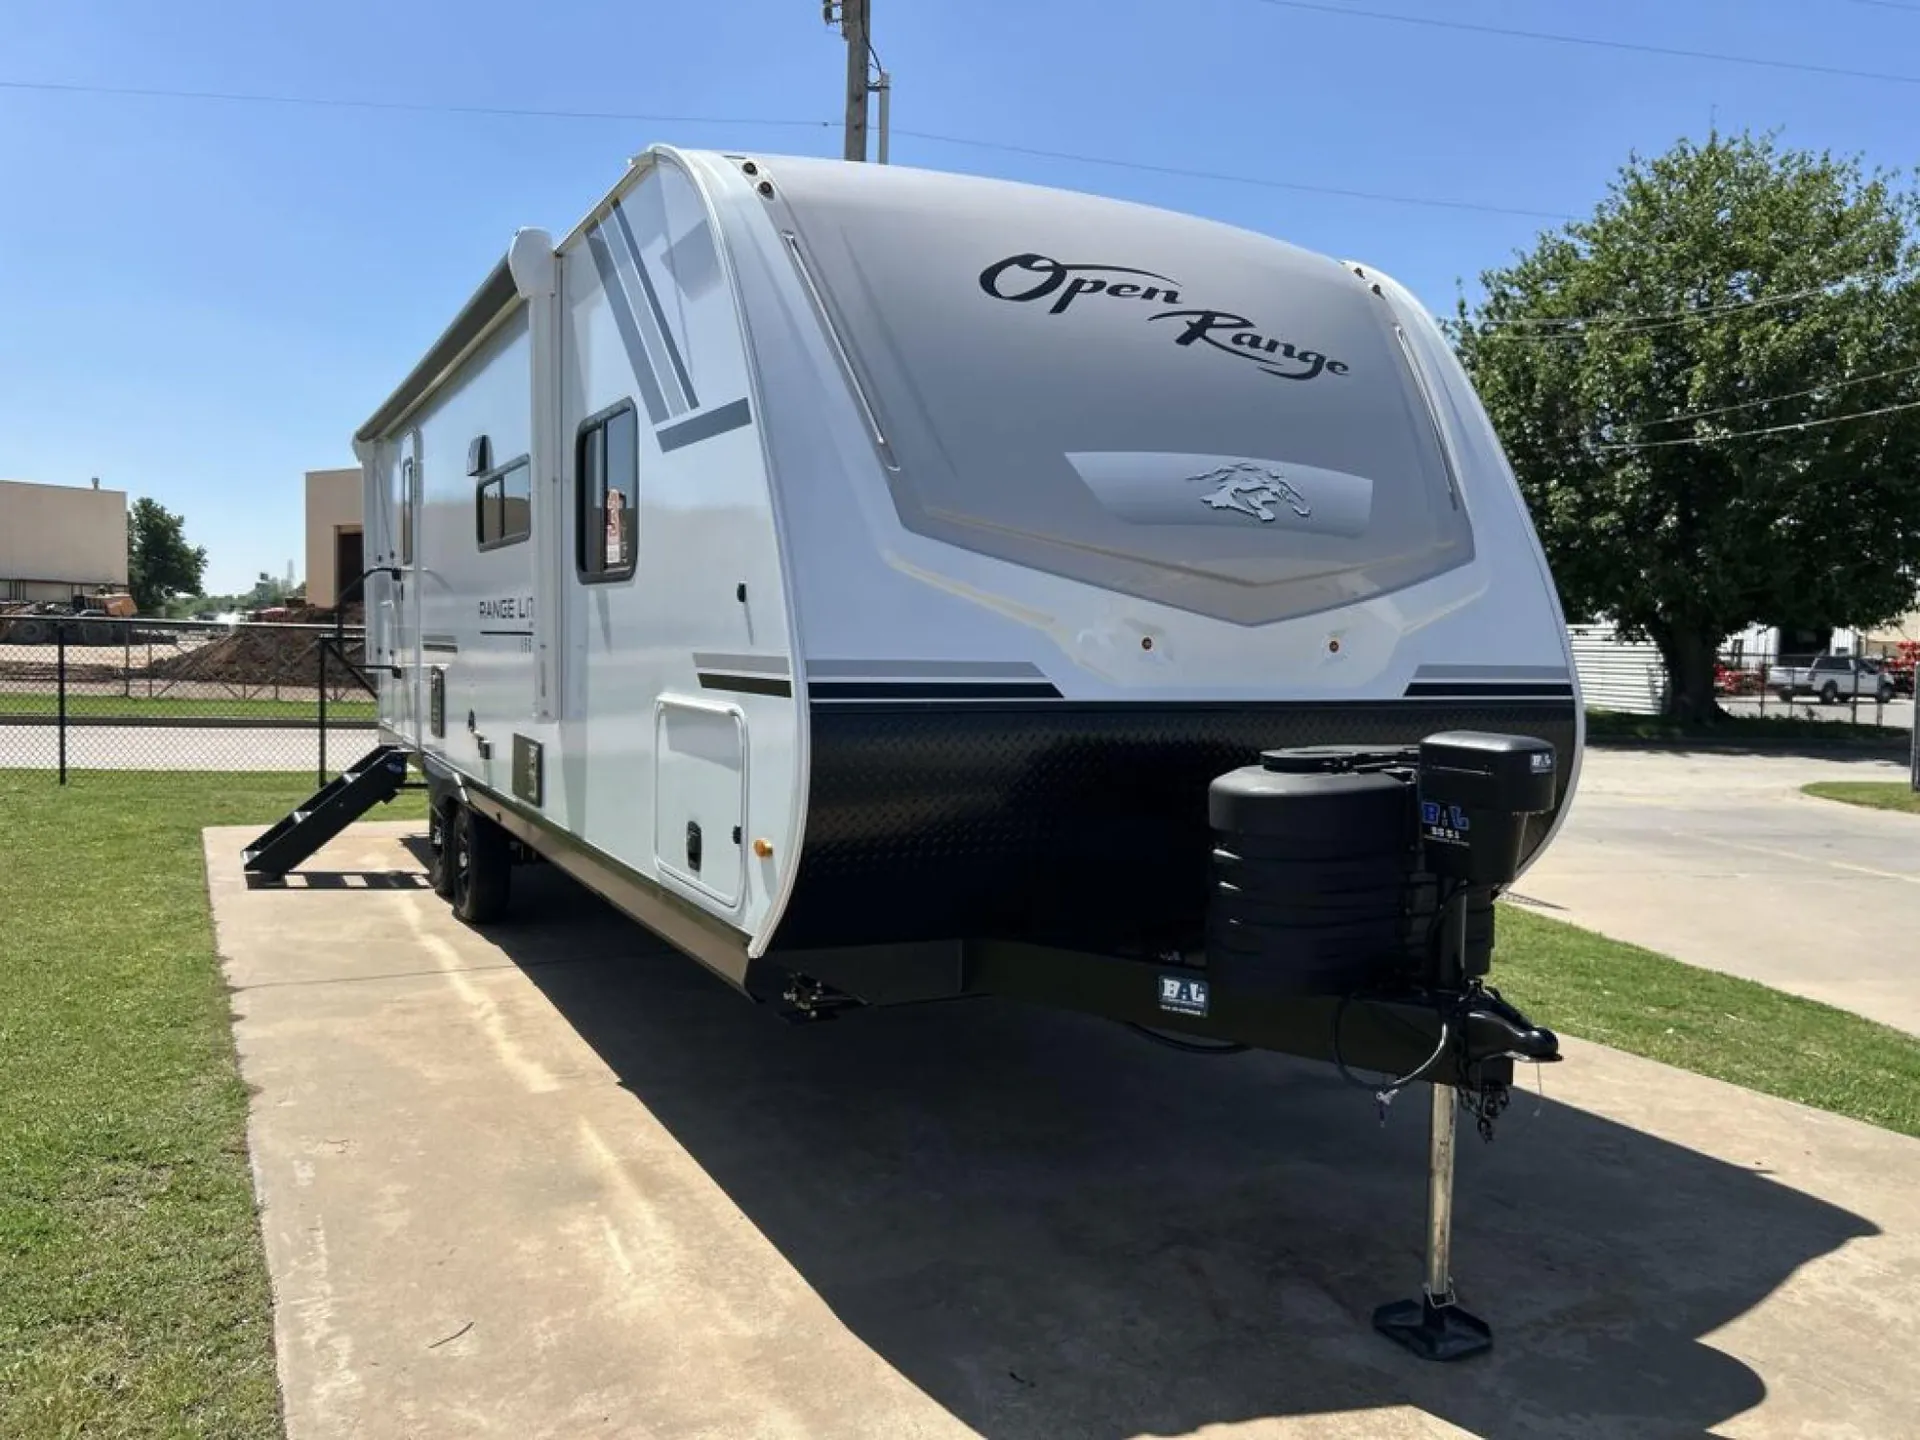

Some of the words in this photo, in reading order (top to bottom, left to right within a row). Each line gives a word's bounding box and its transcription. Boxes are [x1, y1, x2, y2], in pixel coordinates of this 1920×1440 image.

[979, 253, 1183, 314] Open
[1147, 310, 1350, 380] Range
[479, 598, 515, 619] RANGE
